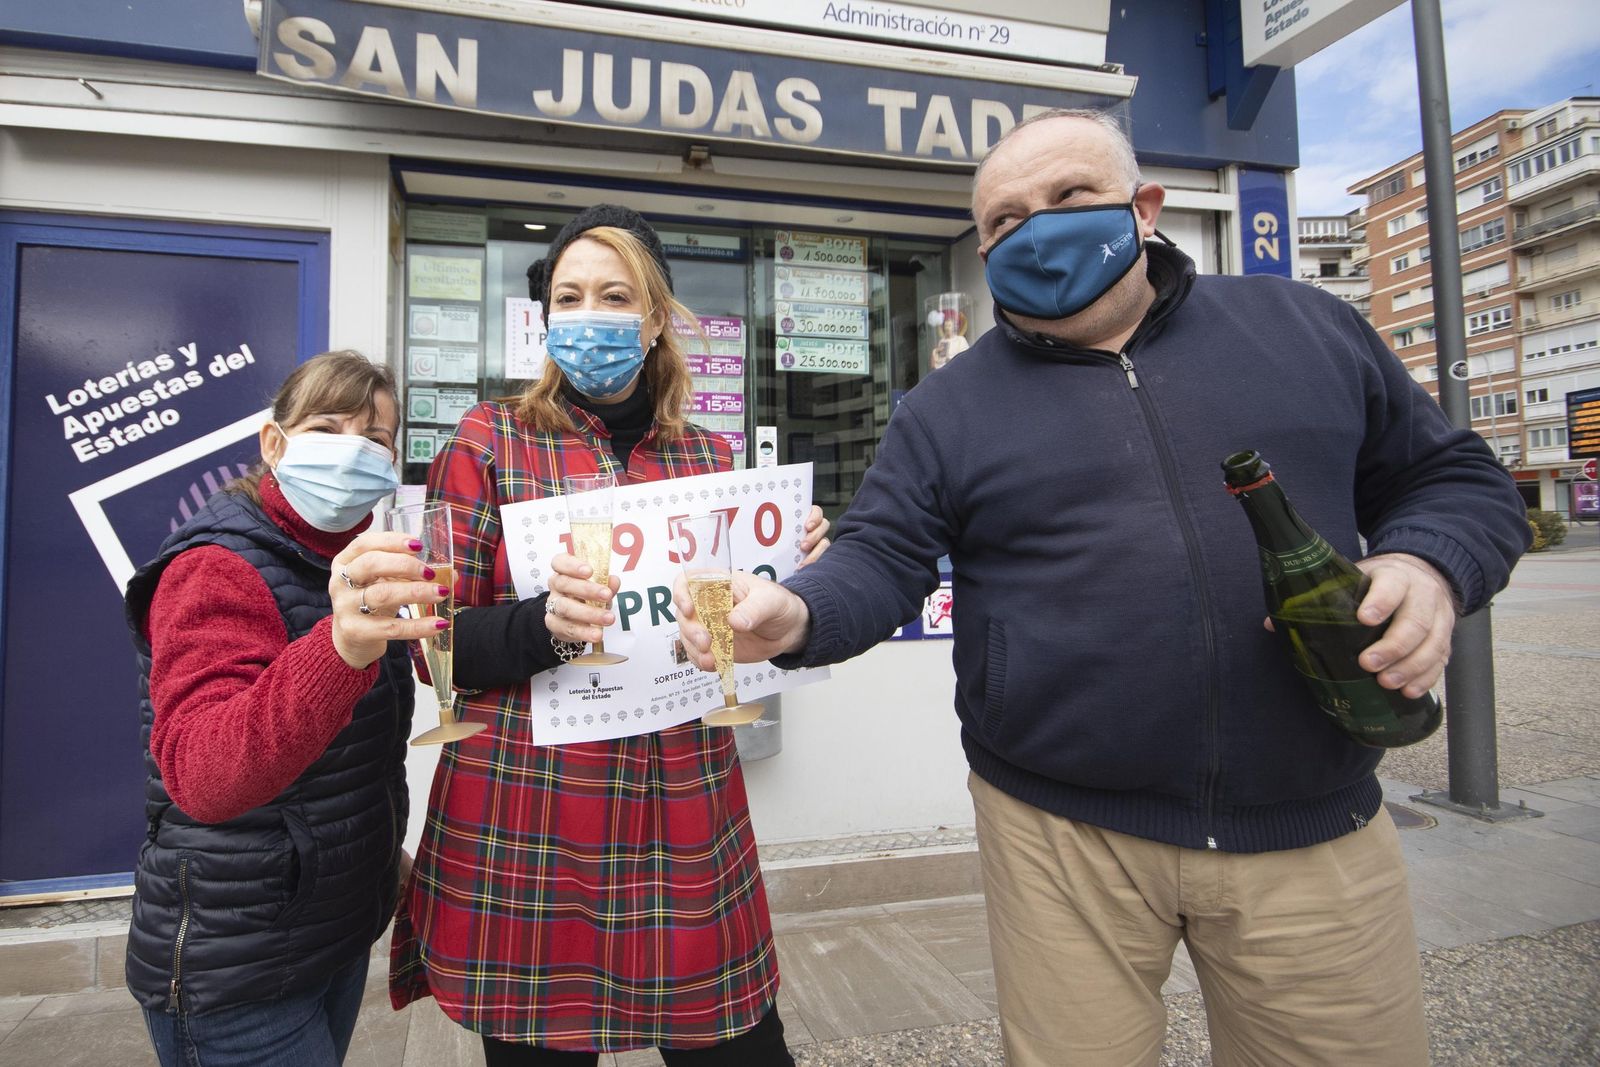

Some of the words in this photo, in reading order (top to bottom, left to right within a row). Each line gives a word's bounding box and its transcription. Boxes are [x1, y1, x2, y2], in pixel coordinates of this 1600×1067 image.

[823, 2, 962, 38] Administración
[988, 24, 1011, 45] 29
[1264, 7, 1310, 41] Estado
[272, 16, 479, 108] SAN
[532, 48, 824, 144] JUDAS
[866, 86, 1054, 161] TAD
[823, 237, 862, 252] BOTE
[1253, 211, 1280, 262] 29
[823, 273, 862, 287] BOTE
[824, 308, 864, 321] BOTE
[824, 342, 864, 356] BOTE
[44, 352, 176, 416] Loterías
[177, 342, 199, 368] y
[63, 369, 204, 440] Apuestas
[208, 343, 256, 378] del
[70, 408, 181, 463] Estado
[654, 671, 684, 685] SORTEO
[685, 668, 695, 677] DE
